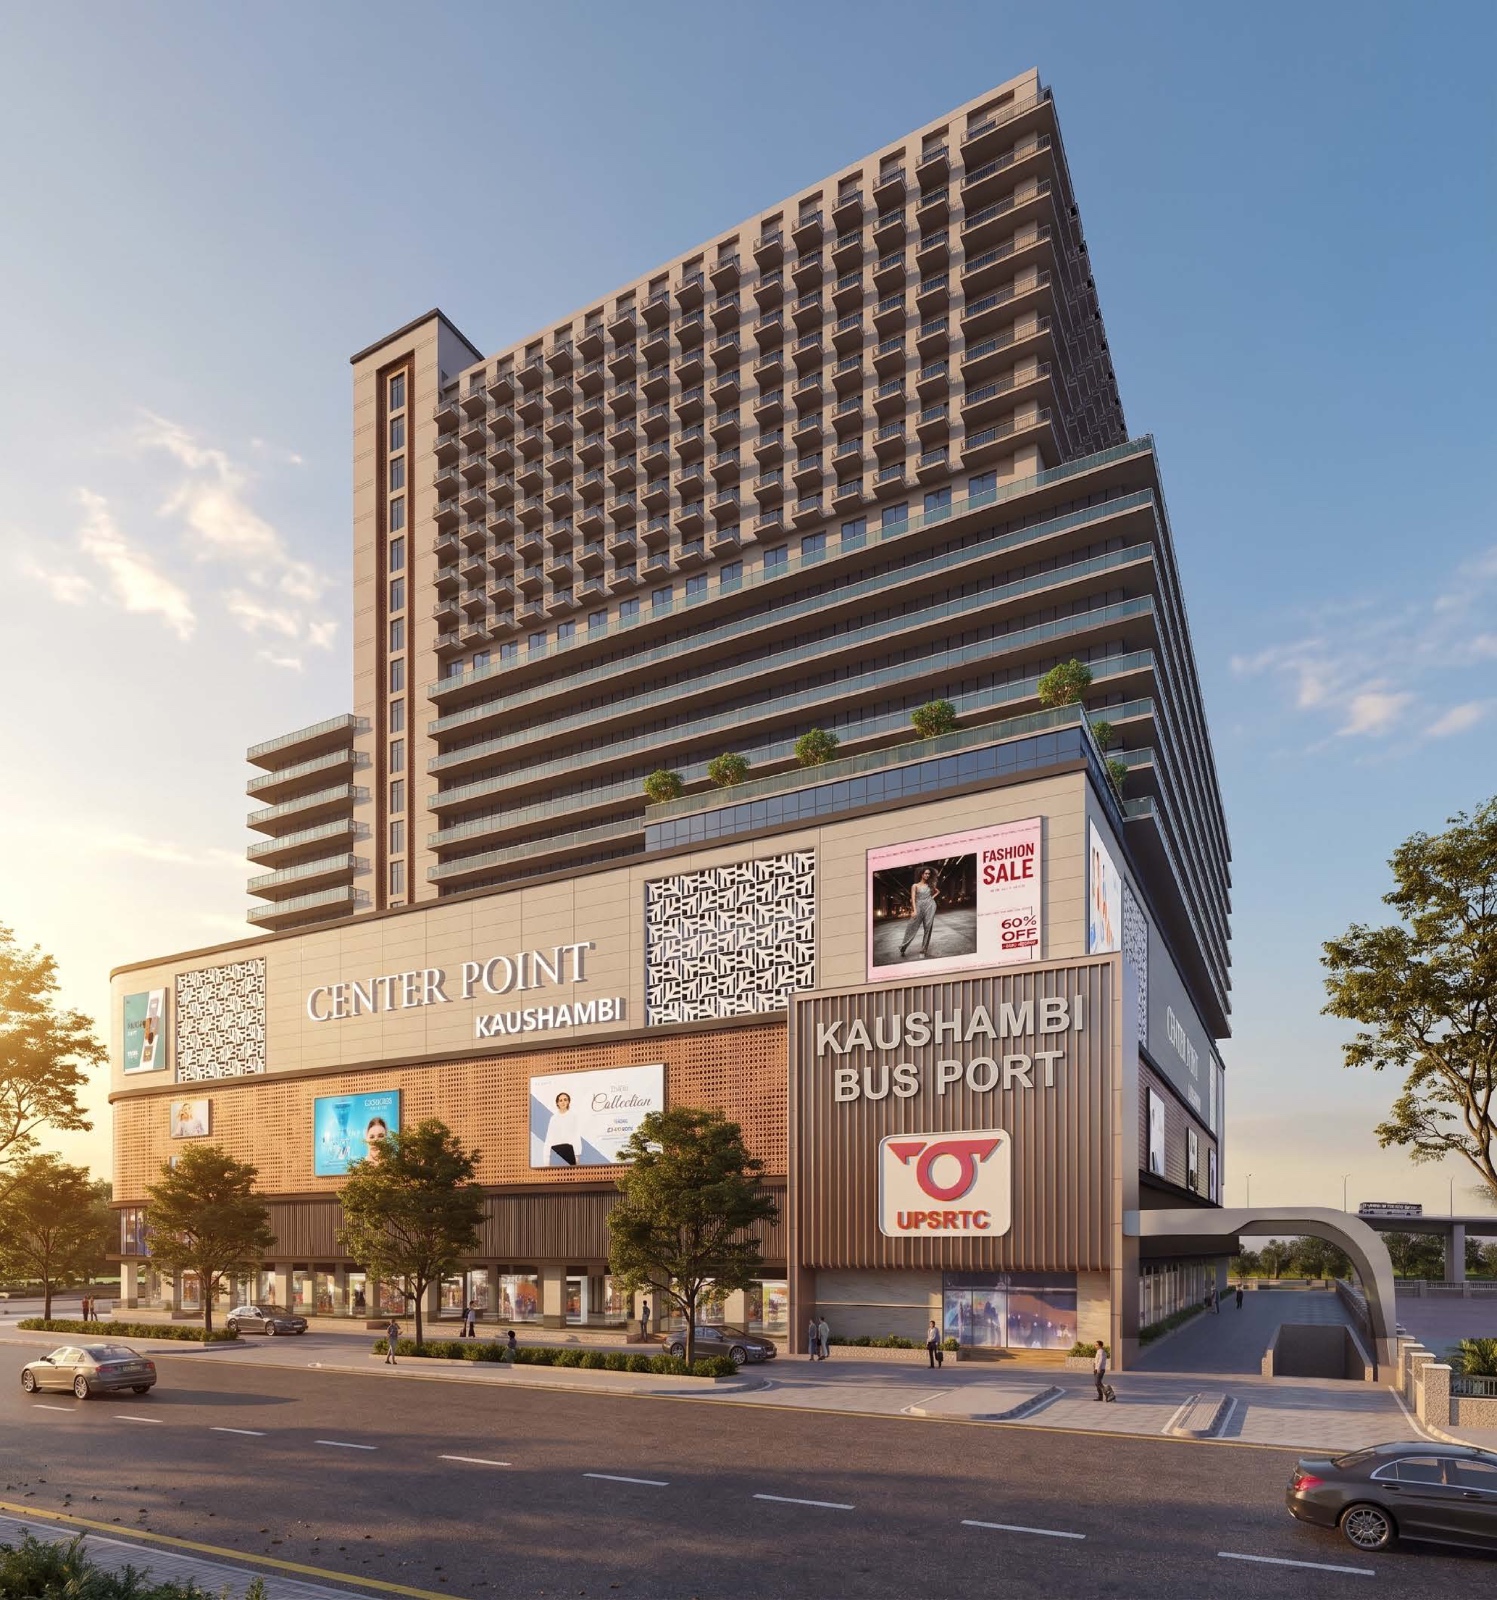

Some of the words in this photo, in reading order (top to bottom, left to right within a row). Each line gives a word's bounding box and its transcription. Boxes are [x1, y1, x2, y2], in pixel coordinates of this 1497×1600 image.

[983, 843, 1035, 864] FASHION
[983, 858, 1034, 885] SALE
[1001, 915, 1037, 929] 60%
[1001, 928, 1037, 941] OFF
[306, 967, 451, 1021] CENTER
[460, 941, 593, 999] POINT
[475, 997, 622, 1038] KAUSHAMBI
[816, 995, 1084, 1057] KAUSHAMBI
[834, 1063, 920, 1102] BUS
[937, 1050, 1064, 1095] PORT
[591, 1092, 652, 1112] Collection
[896, 1210, 991, 1230] UPSRTC
